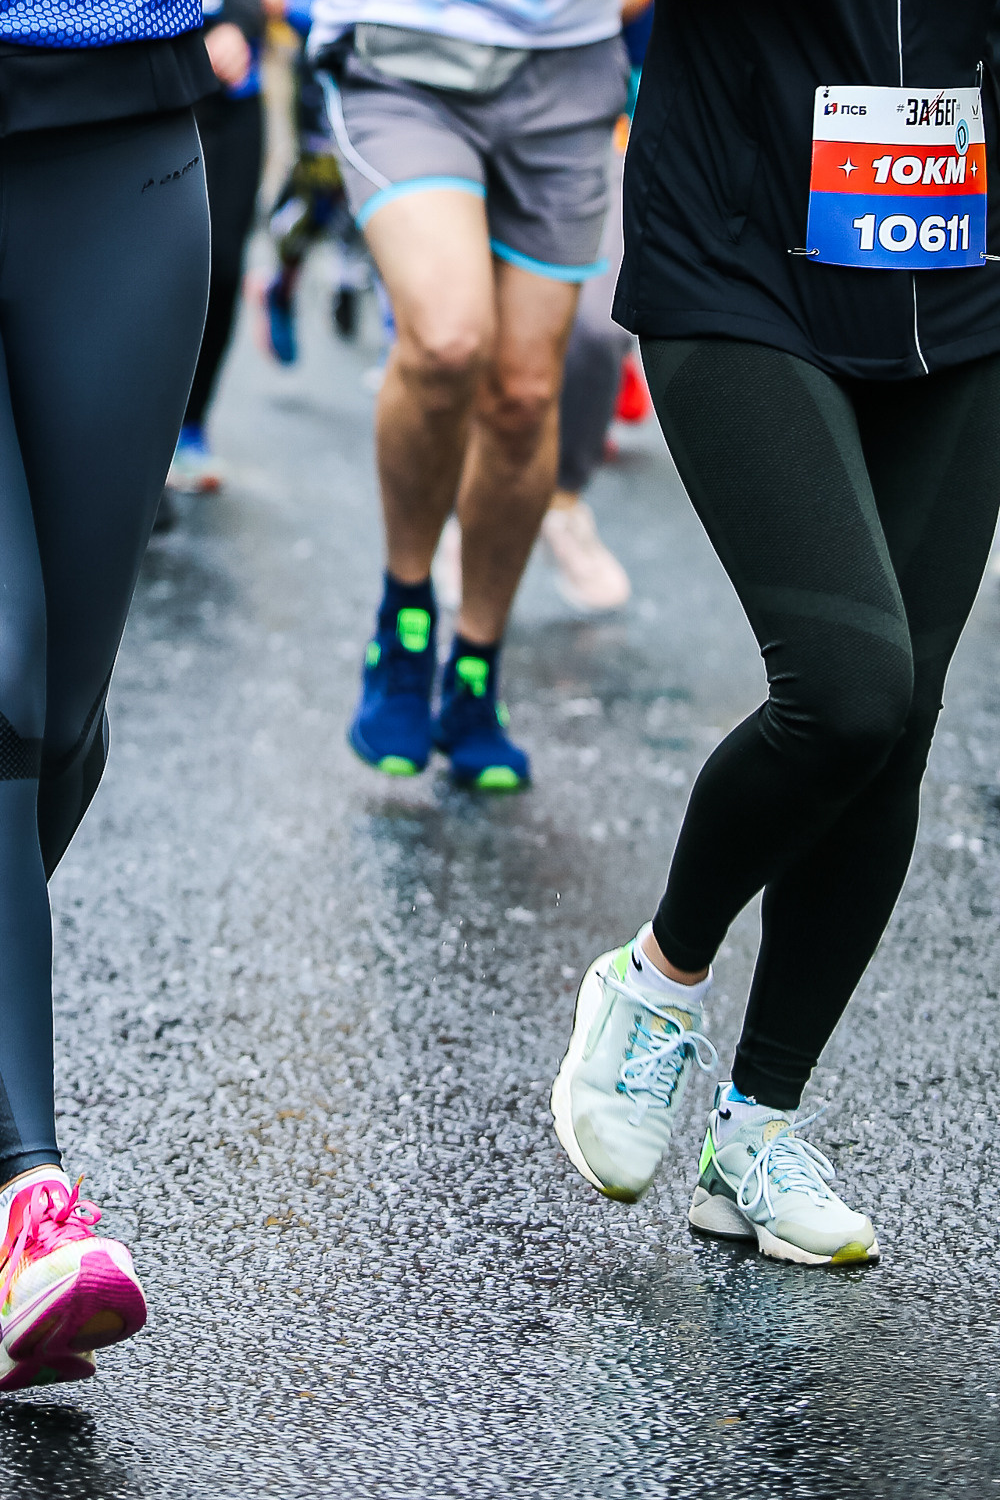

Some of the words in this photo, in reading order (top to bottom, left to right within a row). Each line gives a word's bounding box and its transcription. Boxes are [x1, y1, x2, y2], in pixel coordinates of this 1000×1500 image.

[841, 105, 867, 116] ПСБ
[872, 155, 967, 185] 10КМ
[853, 213, 970, 252] 10611
